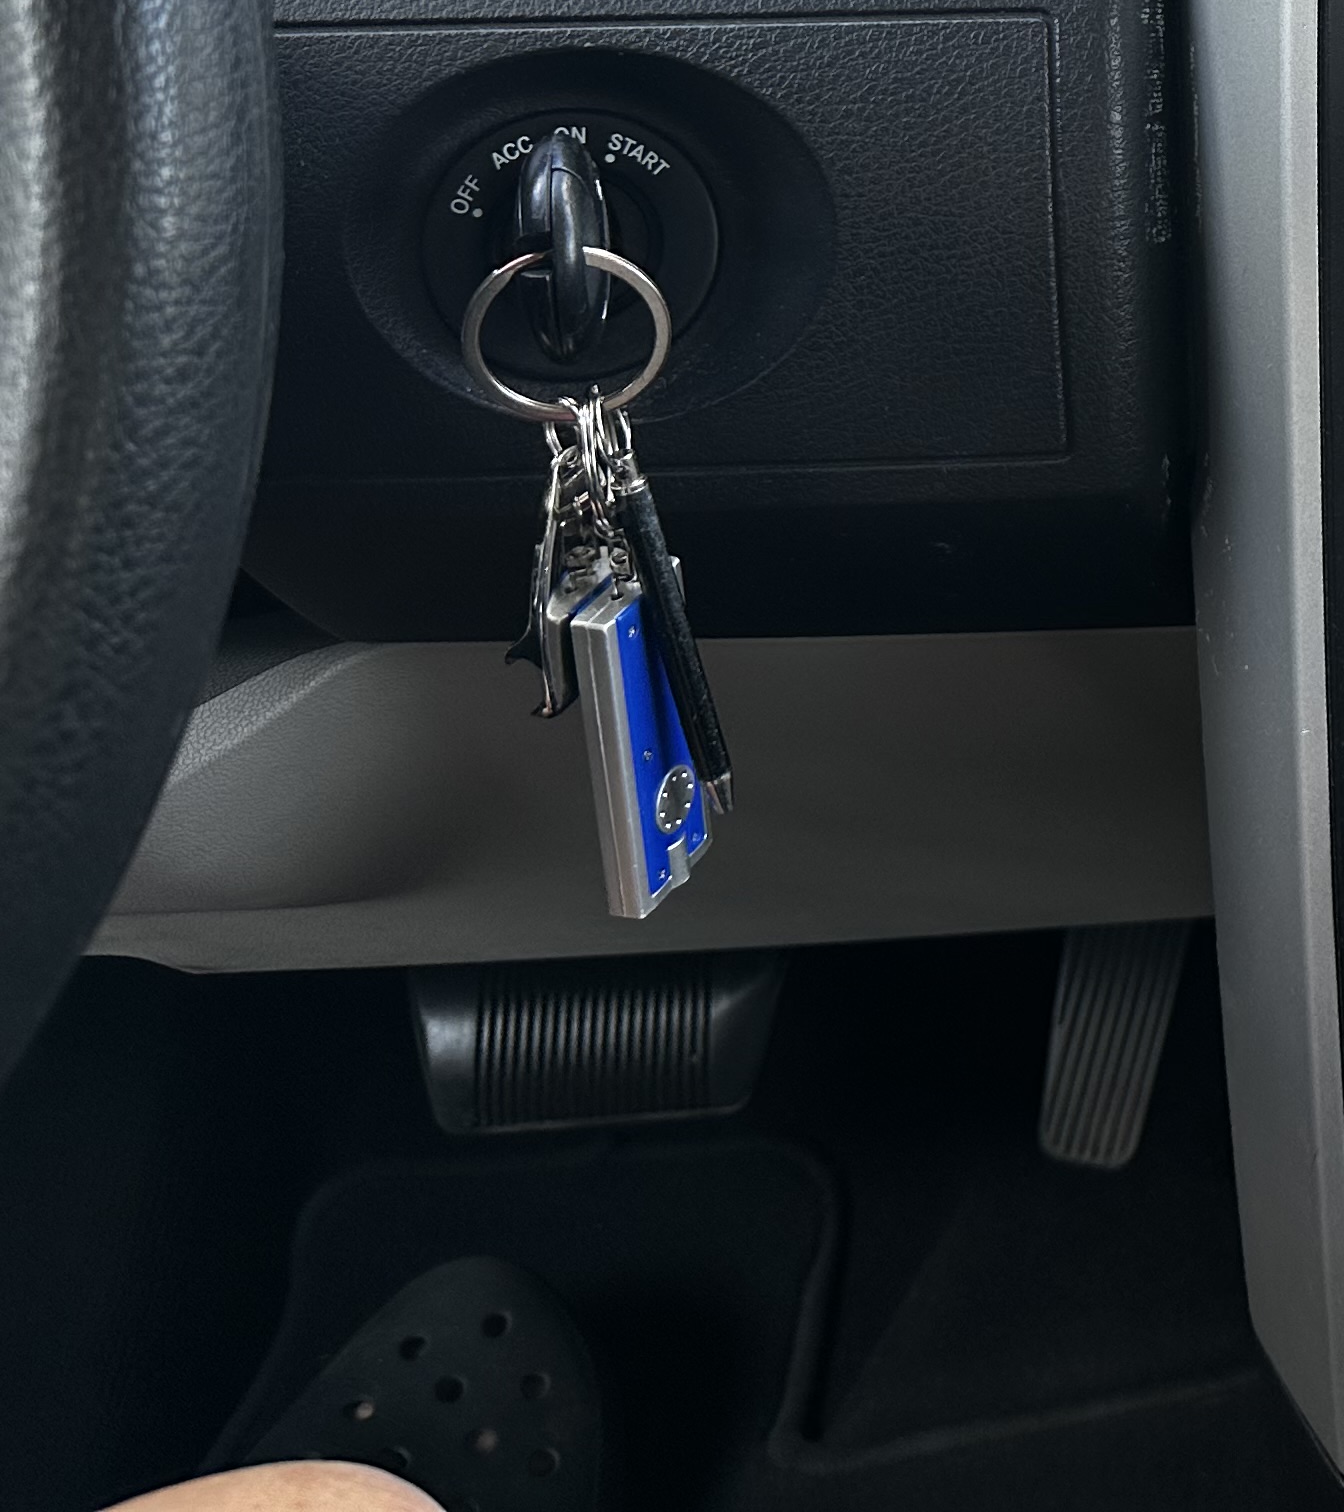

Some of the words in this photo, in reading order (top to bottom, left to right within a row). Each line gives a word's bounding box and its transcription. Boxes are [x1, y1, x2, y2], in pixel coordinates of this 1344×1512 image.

[491, 135, 534, 170] ACC
[607, 132, 671, 176] START
[450, 174, 481, 215] OFF
